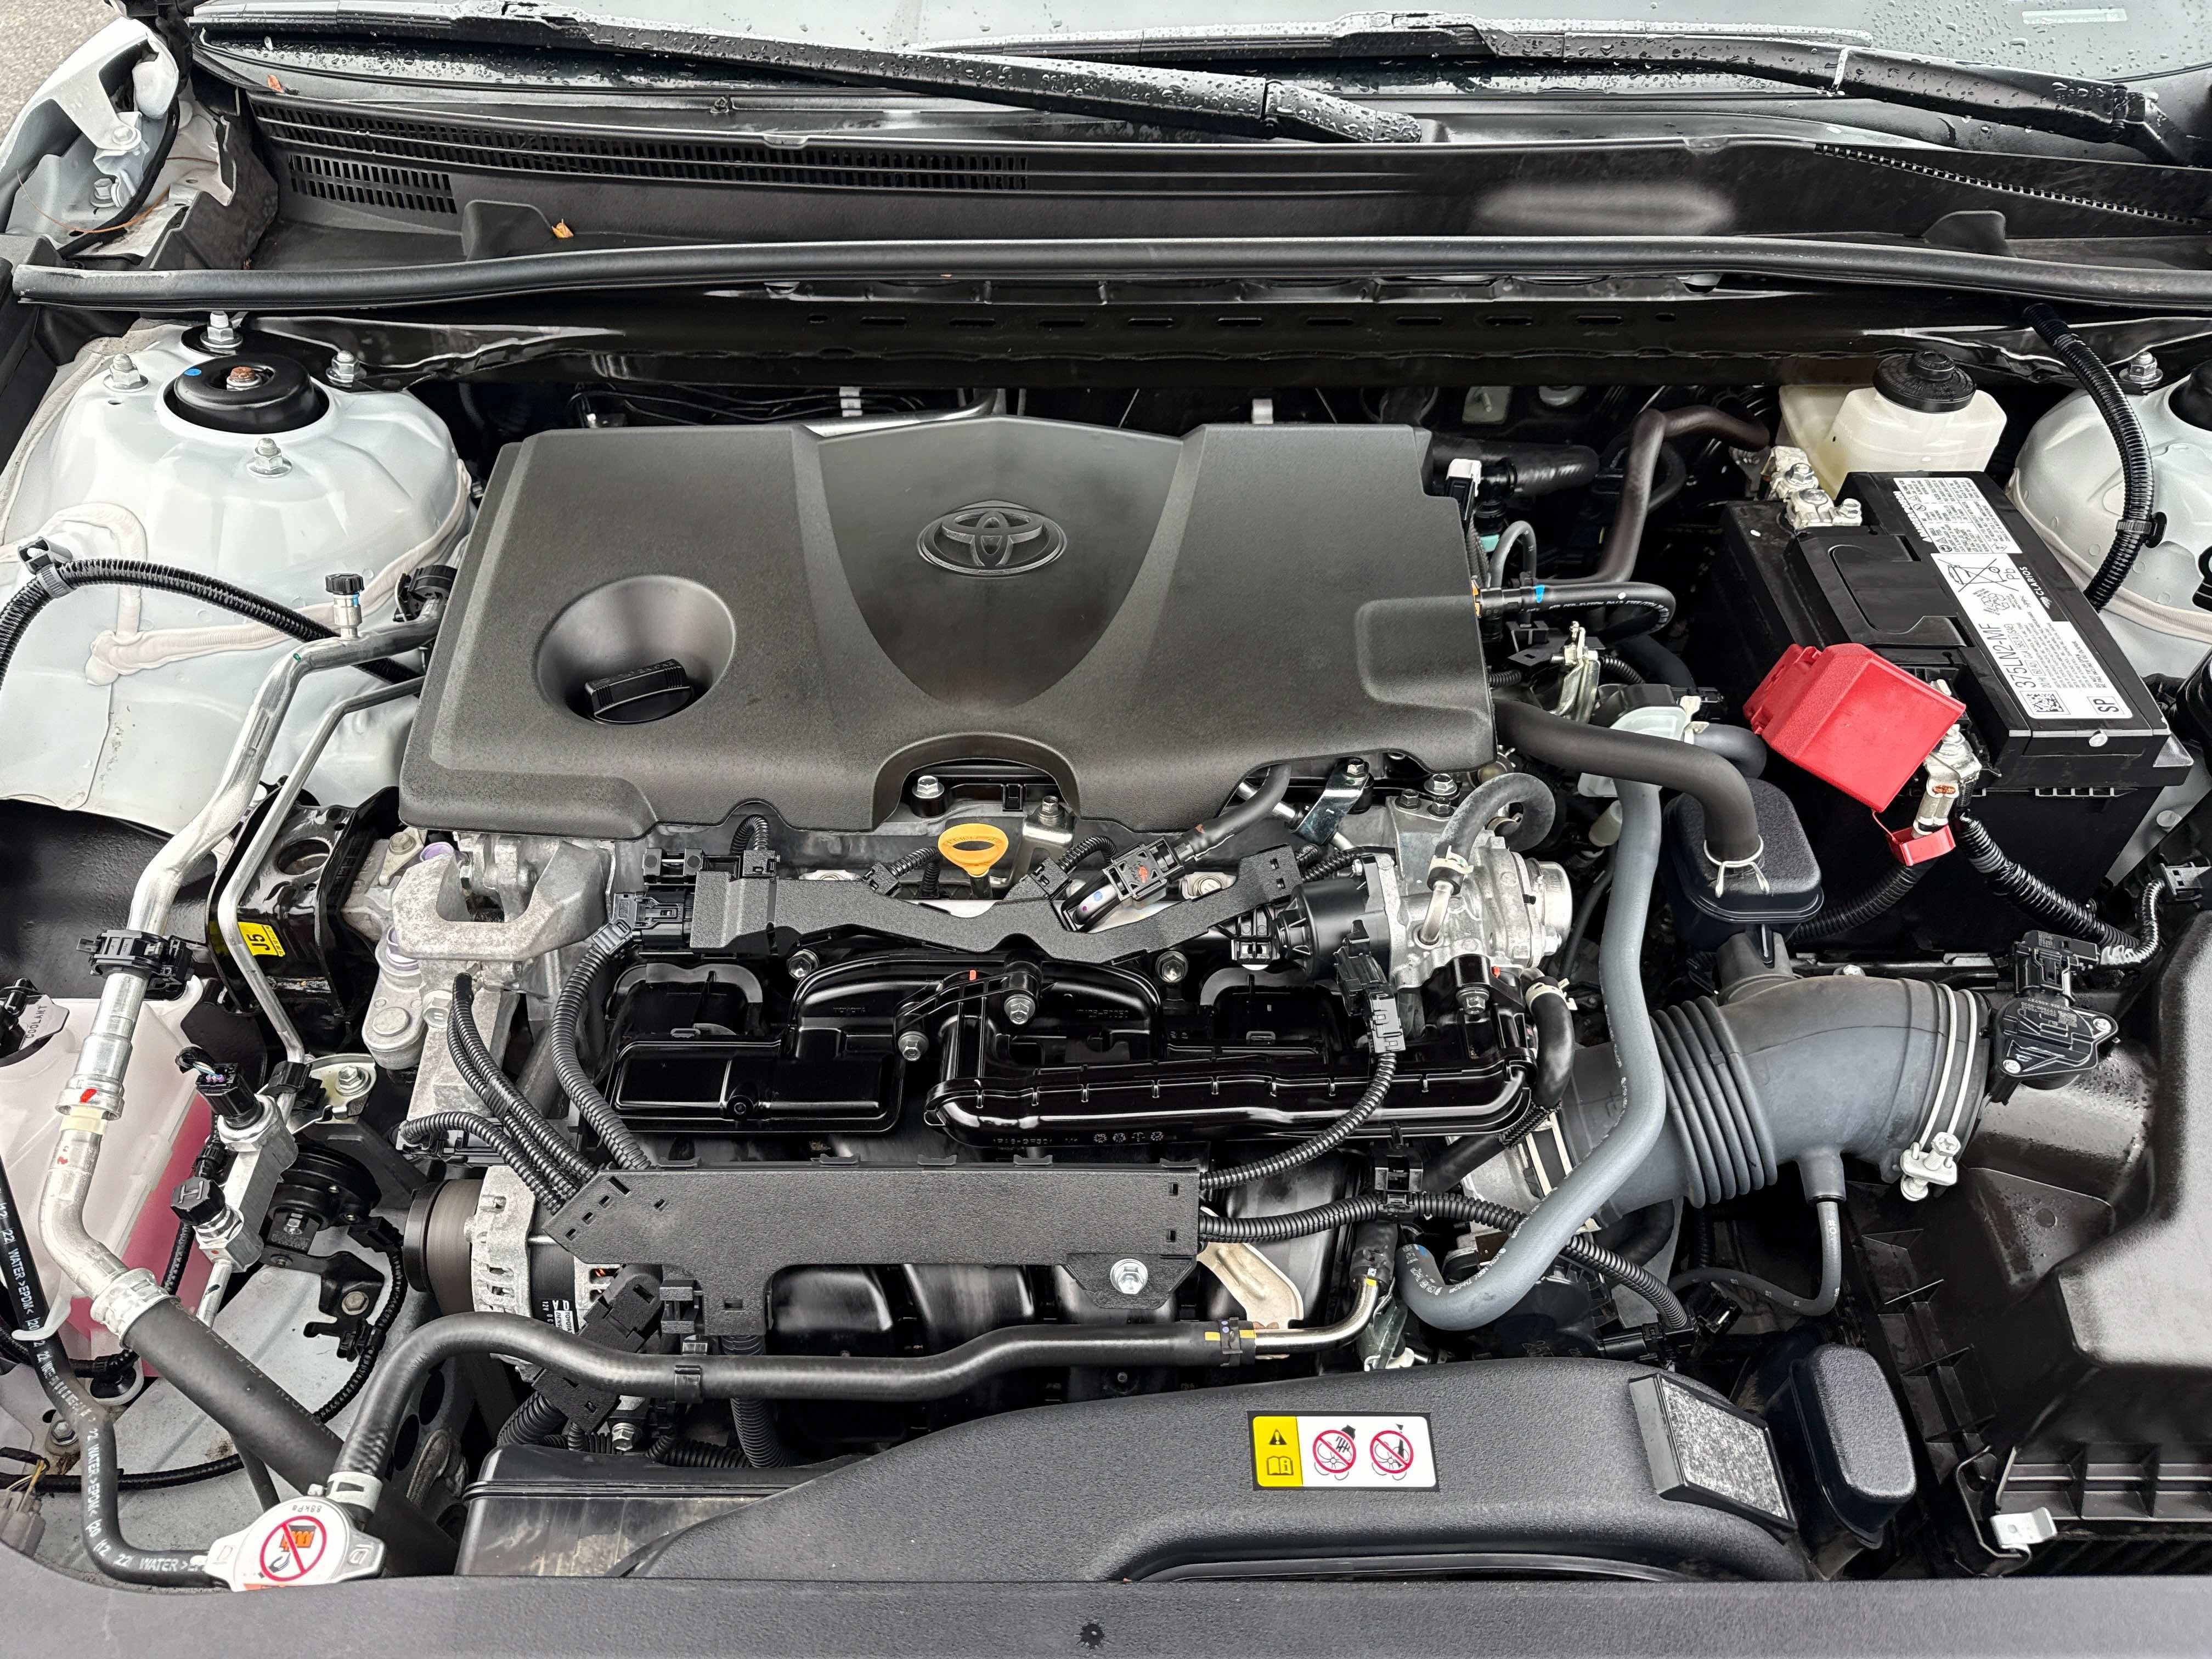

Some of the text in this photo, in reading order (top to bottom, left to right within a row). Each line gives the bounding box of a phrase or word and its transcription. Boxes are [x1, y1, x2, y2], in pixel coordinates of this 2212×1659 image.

[2000, 568, 2020, 579] Pb
[2018, 567, 2045, 595] CLARIOS
[1977, 623, 2038, 687] 375LN2-MF
[2091, 699, 2120, 712] SP
[246, 934, 270, 950] J5
[25, 1005, 47, 1039] COOLANT
[178, 1181, 204, 1204] H
[8, 1248, 25, 1280] WATER
[18, 1282, 35, 1316] >EPDM<
[88, 1443, 100, 1475] WATER
[139, 1558, 179, 1572] WATER
[292, 1505, 323, 1513] 88kPa
